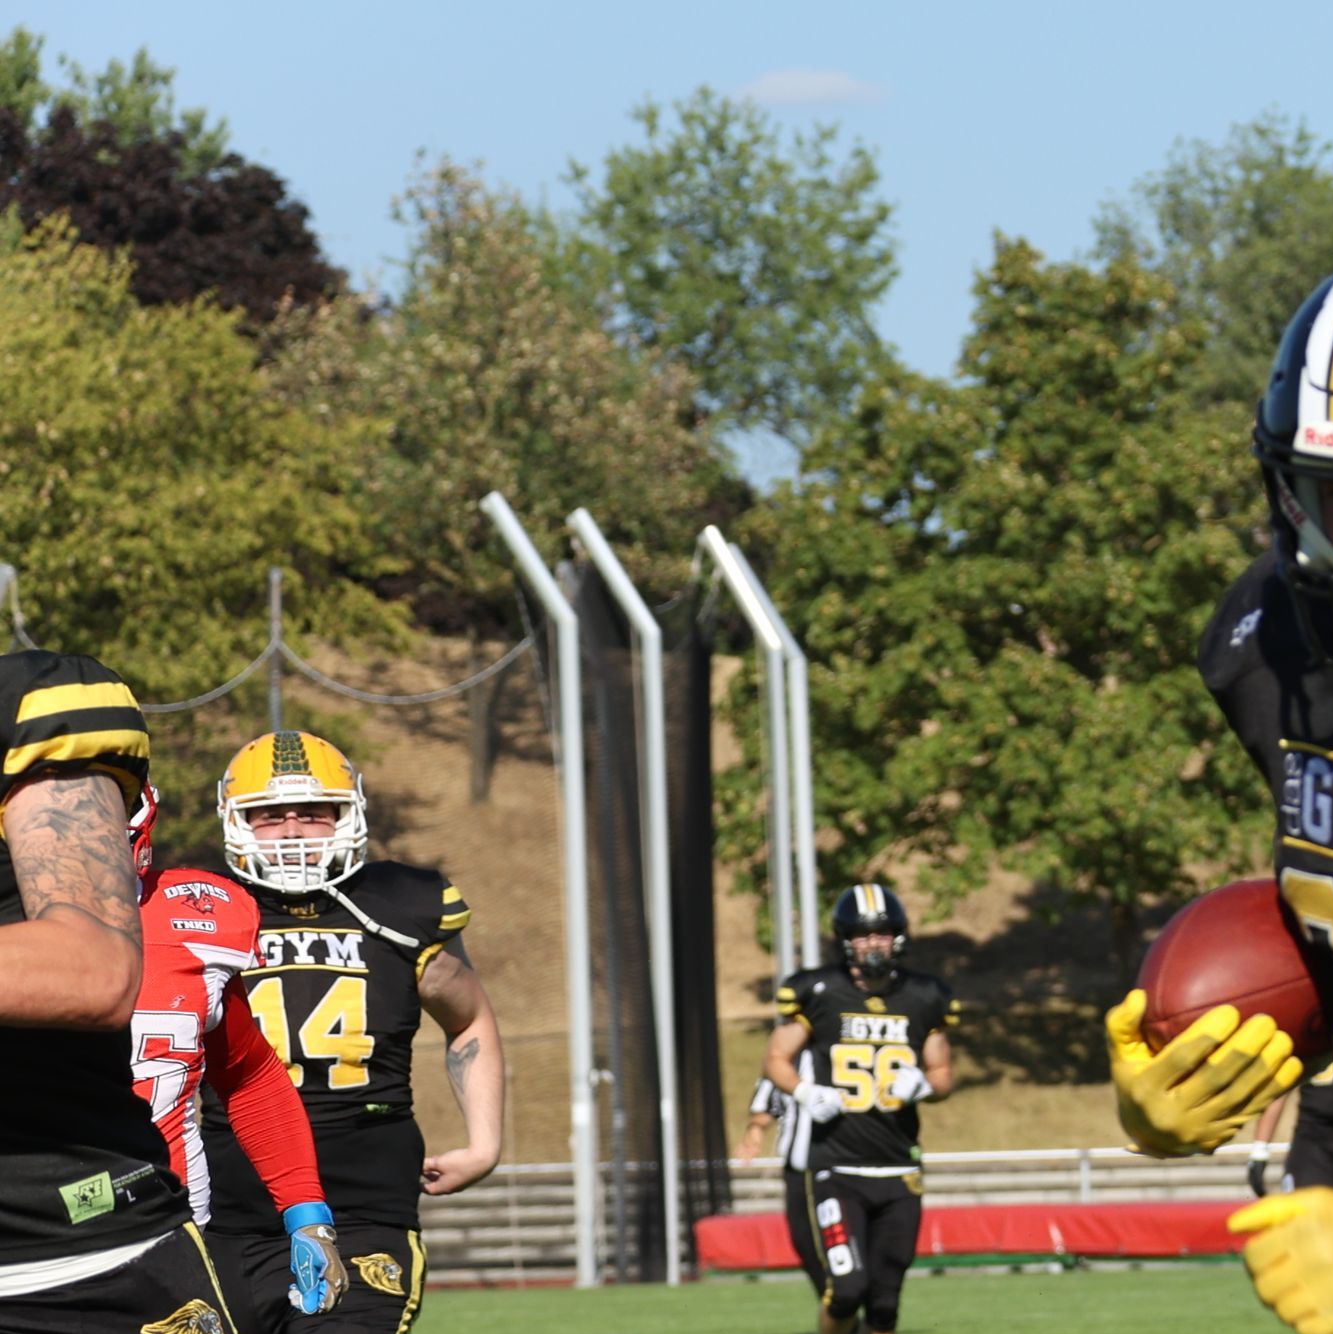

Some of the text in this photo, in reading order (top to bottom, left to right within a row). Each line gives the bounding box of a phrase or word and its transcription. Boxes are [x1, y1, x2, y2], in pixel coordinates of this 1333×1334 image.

[163, 882, 230, 902] DEVILS
[172, 920, 214, 932] TNKD
[257, 931, 367, 969] GYM
[247, 975, 376, 1091] 14
[851, 1014, 910, 1041] GYM
